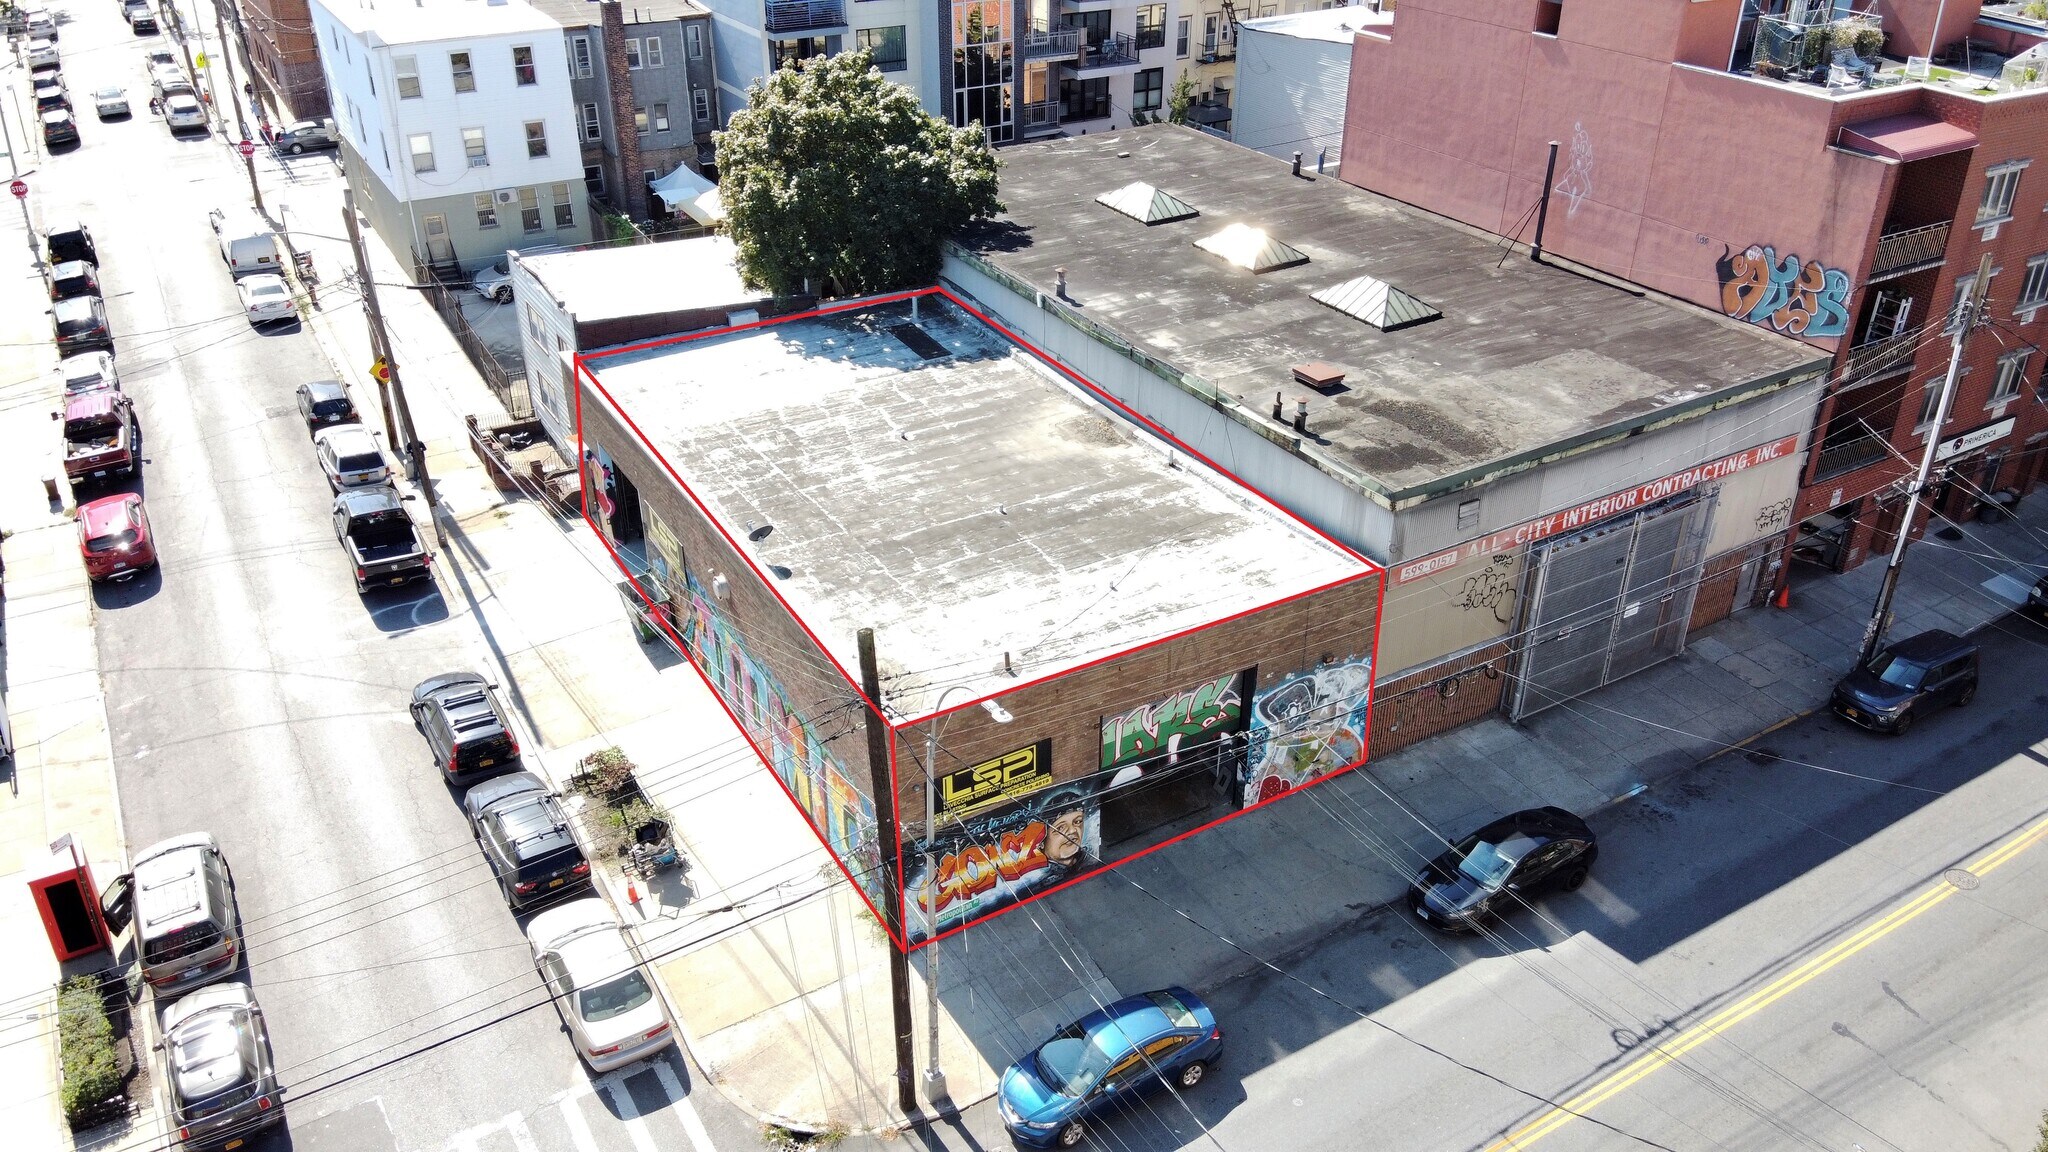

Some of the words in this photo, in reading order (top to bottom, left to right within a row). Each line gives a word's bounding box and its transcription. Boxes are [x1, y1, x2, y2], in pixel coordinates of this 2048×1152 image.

[240, 144, 254, 152] STOP
[11, 185, 27, 193] STOP
[1964, 429, 1997, 446] PRIMERICA
[1562, 491, 1638, 530] INTERIOR
[1755, 443, 1783, 465] INC.
[1404, 554, 1454, 580] 599-0157
[945, 748, 1035, 802] LSP
[974, 782, 1001, 799] SURFACE
[1000, 771, 1037, 789] PREPARATION
